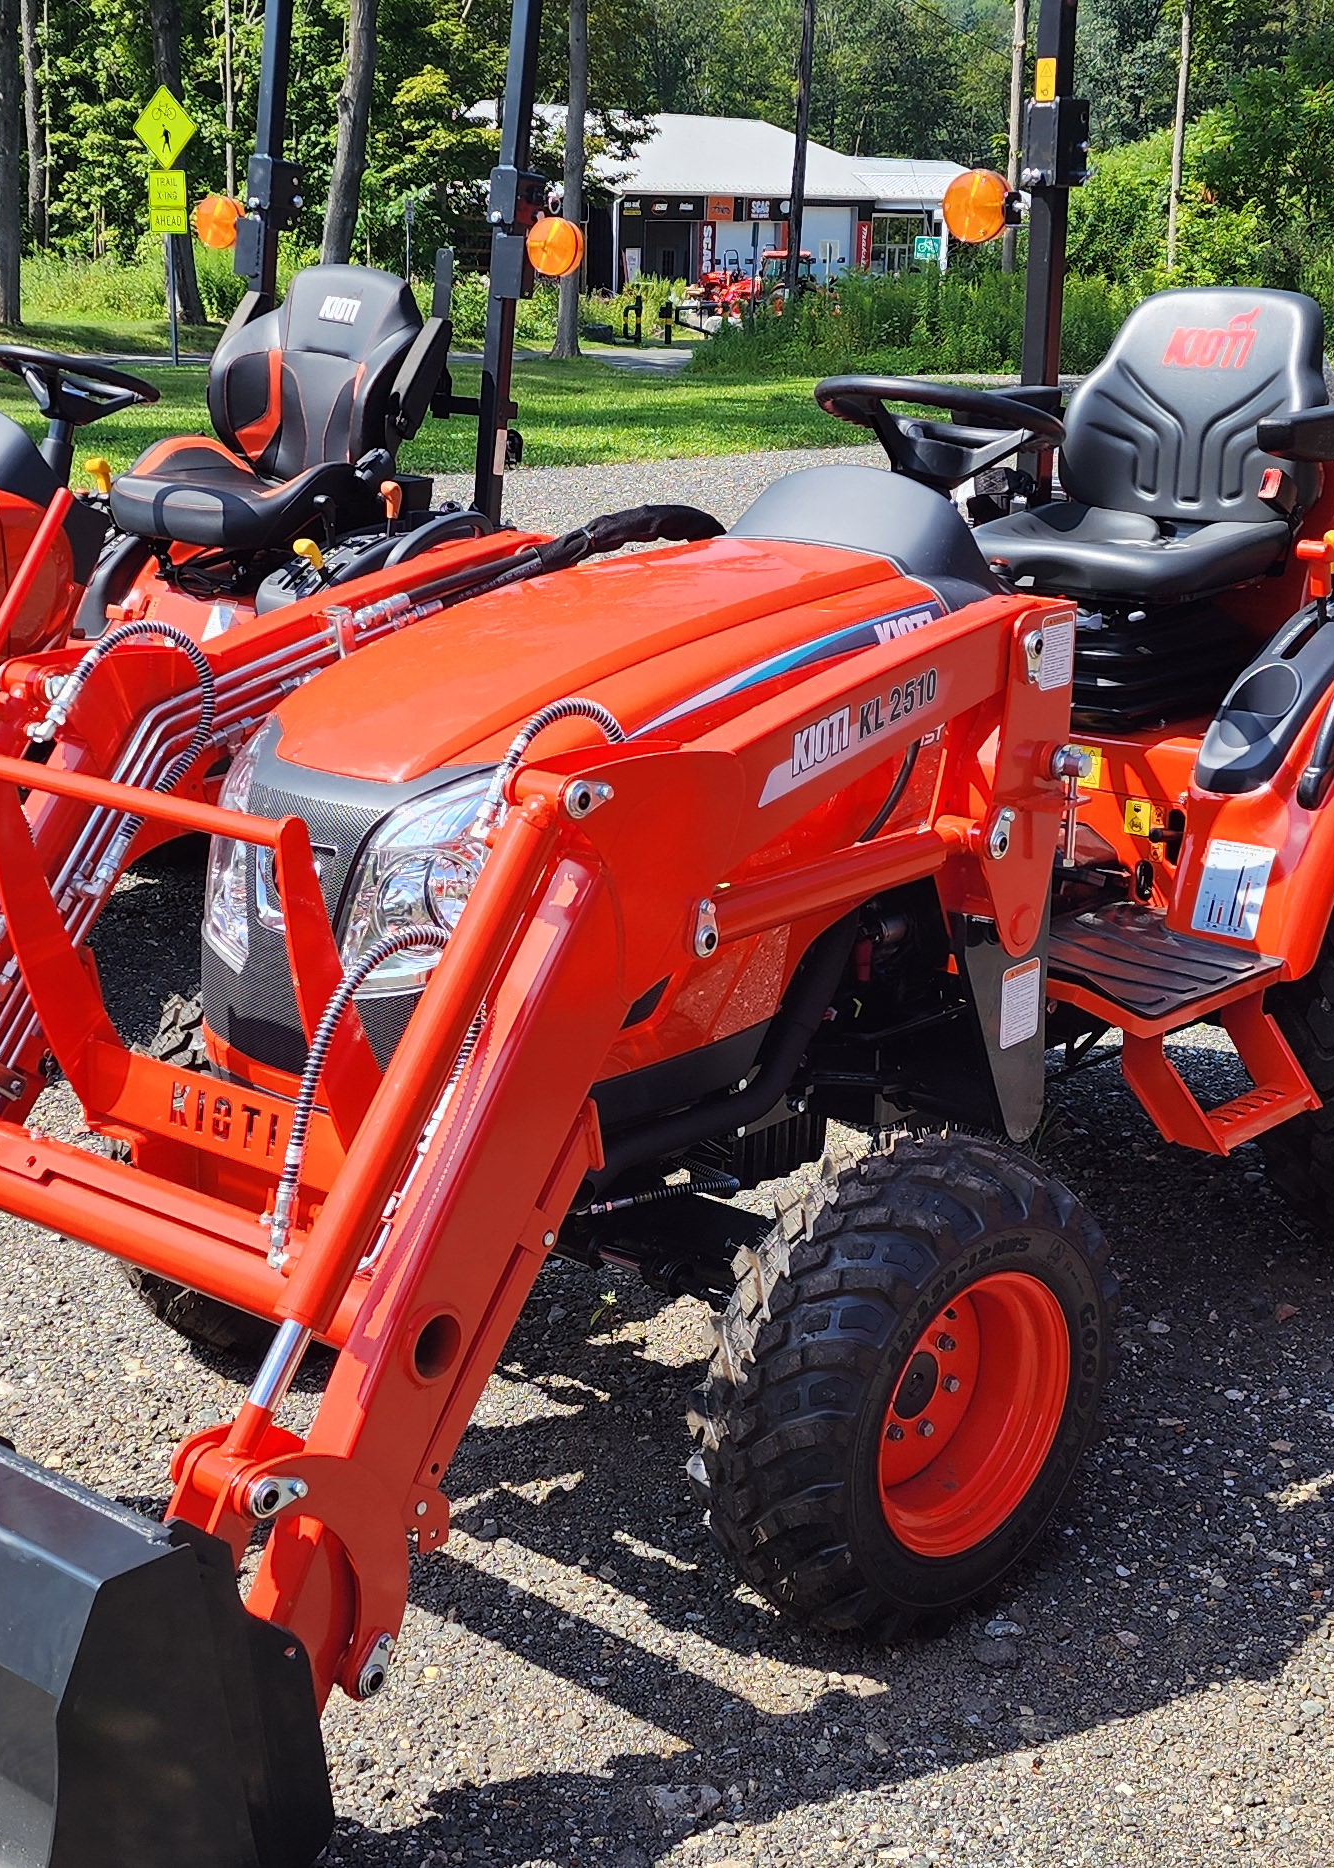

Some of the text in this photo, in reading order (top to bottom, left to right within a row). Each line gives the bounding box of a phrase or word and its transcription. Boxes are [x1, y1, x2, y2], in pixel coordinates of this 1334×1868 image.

[156, 177, 177, 187] TRAIL
[155, 215, 182, 227] AHEAD
[751, 200, 770, 214] SCAG
[703, 225, 713, 273] SCAG
[318, 295, 362, 323] KIOTI
[1161, 325, 1258, 369] KIOTI
[791, 667, 938, 778] KIOTI KL 2510
[169, 1081, 280, 1158] KIOTI
